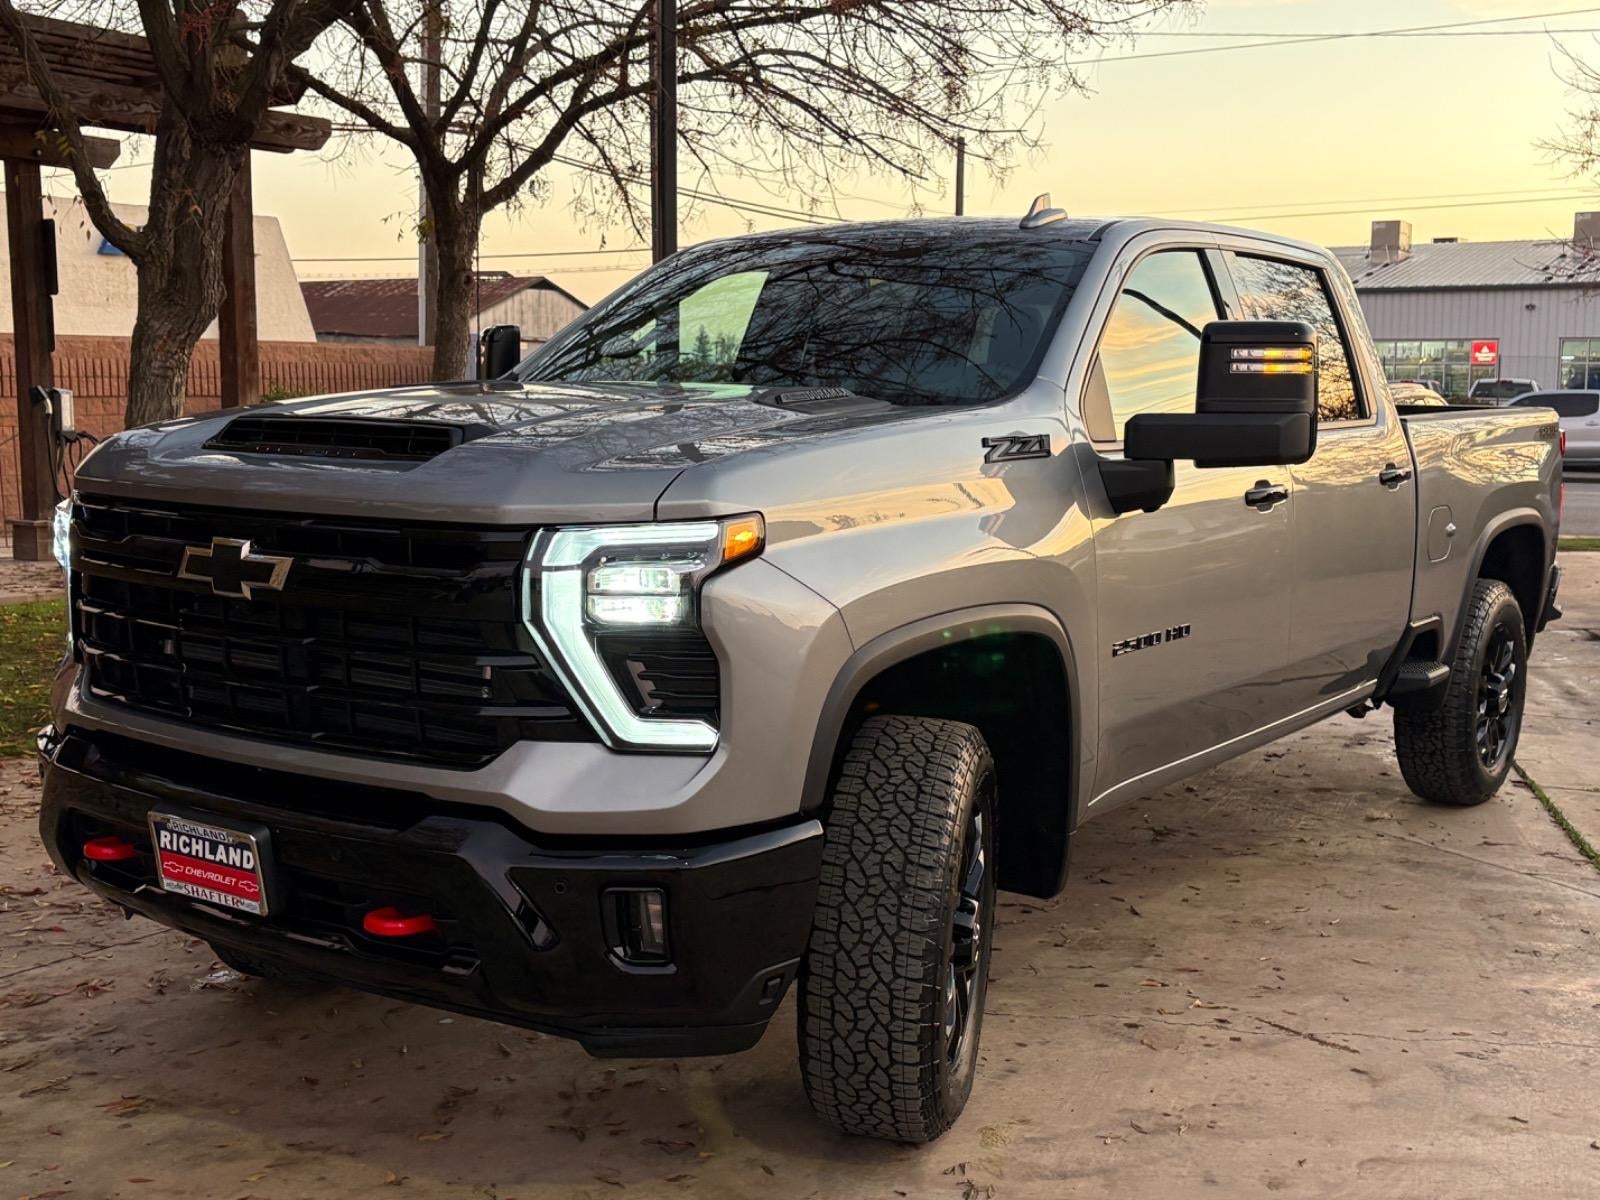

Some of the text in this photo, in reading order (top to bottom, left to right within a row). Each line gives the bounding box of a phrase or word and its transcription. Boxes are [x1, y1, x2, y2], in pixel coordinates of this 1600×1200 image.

[981, 434, 1051, 464] Z71
[1112, 623, 1191, 657] 2500 HD
[173, 823, 226, 840] RICHLAND
[160, 830, 254, 869] RICHLAND
[185, 867, 237, 886] CHEVROLET
[183, 885, 240, 907] SHAFTER
